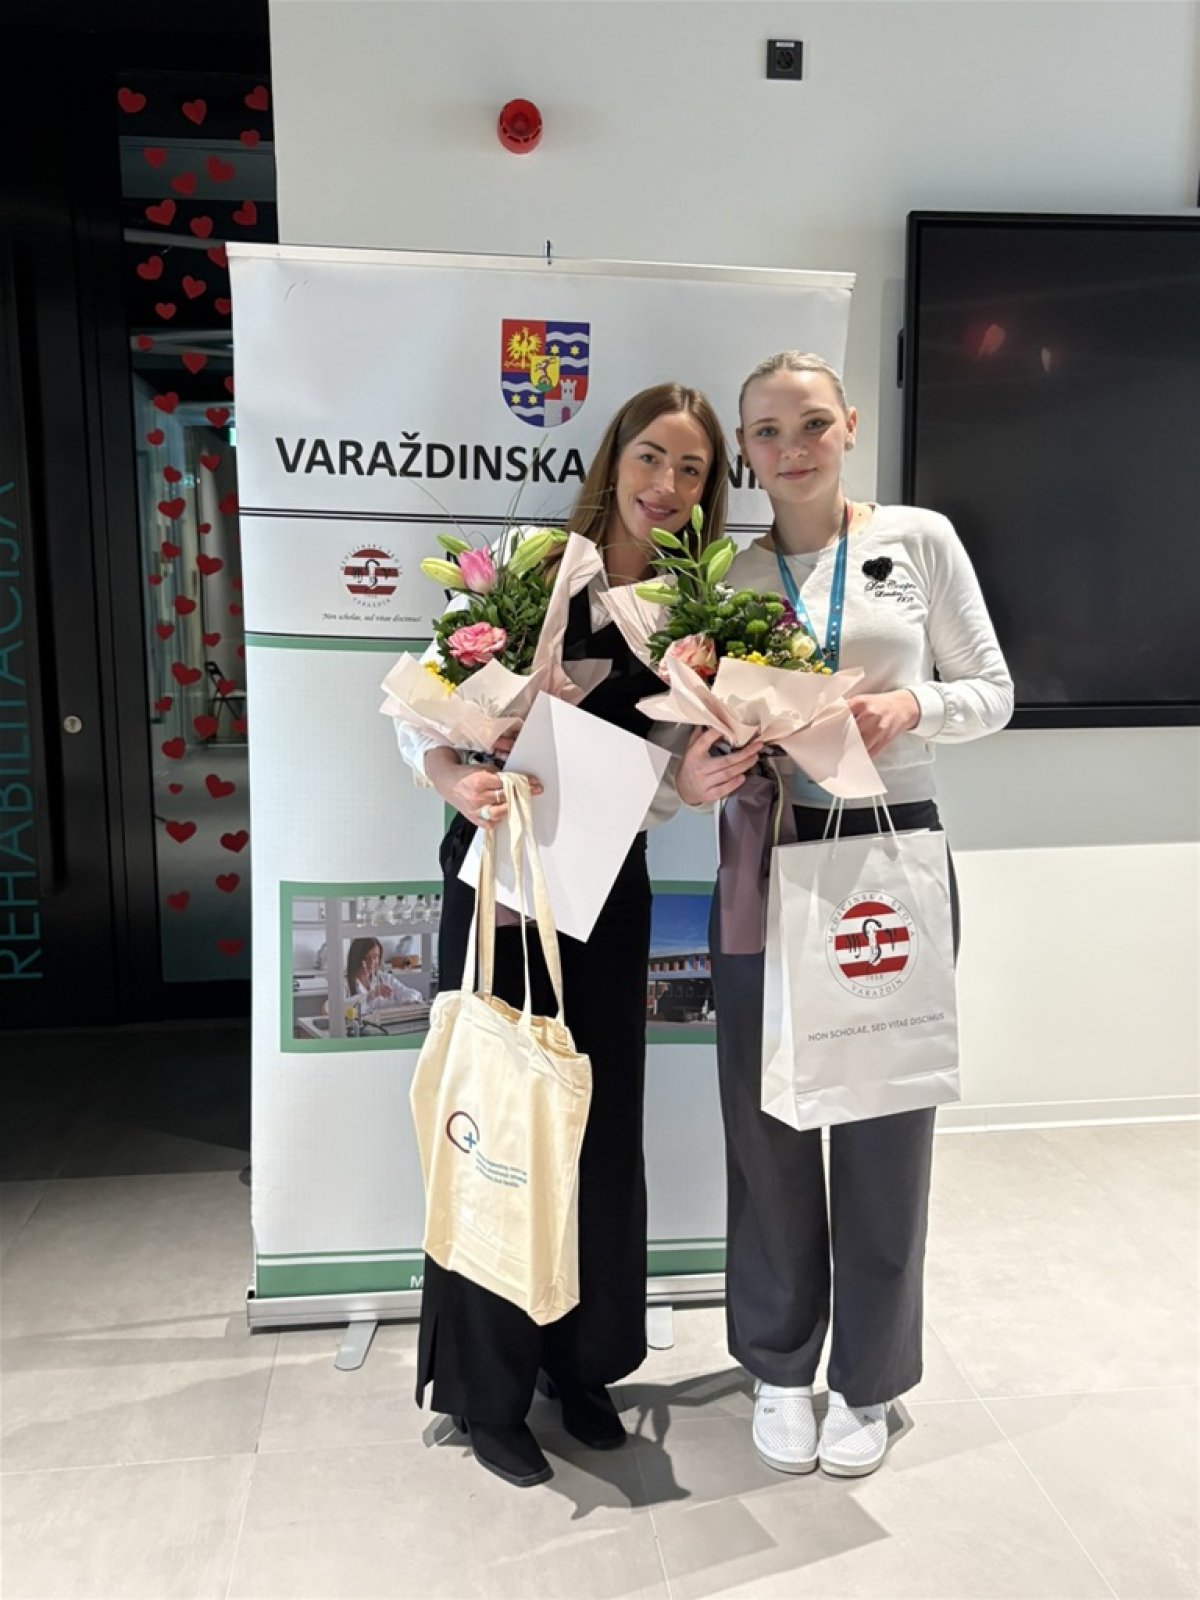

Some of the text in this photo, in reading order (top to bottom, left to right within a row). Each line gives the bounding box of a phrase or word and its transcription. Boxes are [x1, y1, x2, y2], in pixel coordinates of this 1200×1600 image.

[275, 431, 586, 485] VARAŽDINSKA
[828, 894, 884, 943] MEDICINSKA
[851, 978, 903, 997] VARAŽDIN
[808, 1012, 945, 1042] NON SCHOLAE, SED VITAE DISCIMUS
